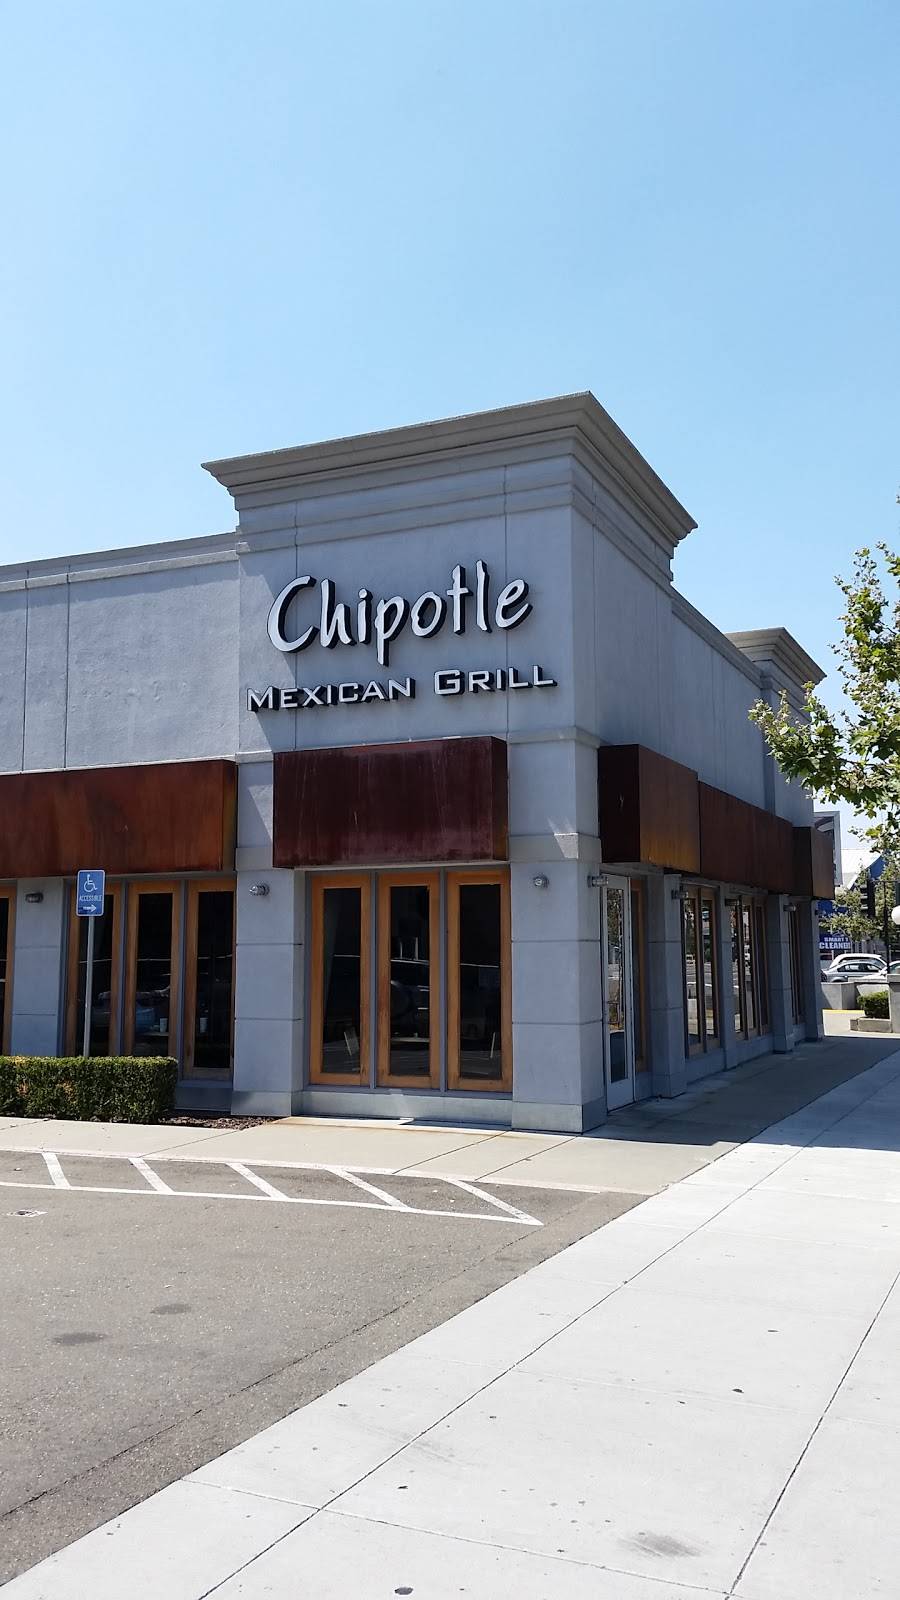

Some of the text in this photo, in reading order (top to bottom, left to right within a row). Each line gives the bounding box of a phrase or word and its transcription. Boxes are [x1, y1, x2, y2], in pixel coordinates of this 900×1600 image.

[267, 559, 533, 667] Chipotle
[247, 665, 557, 712] MEXICAN GRILL
